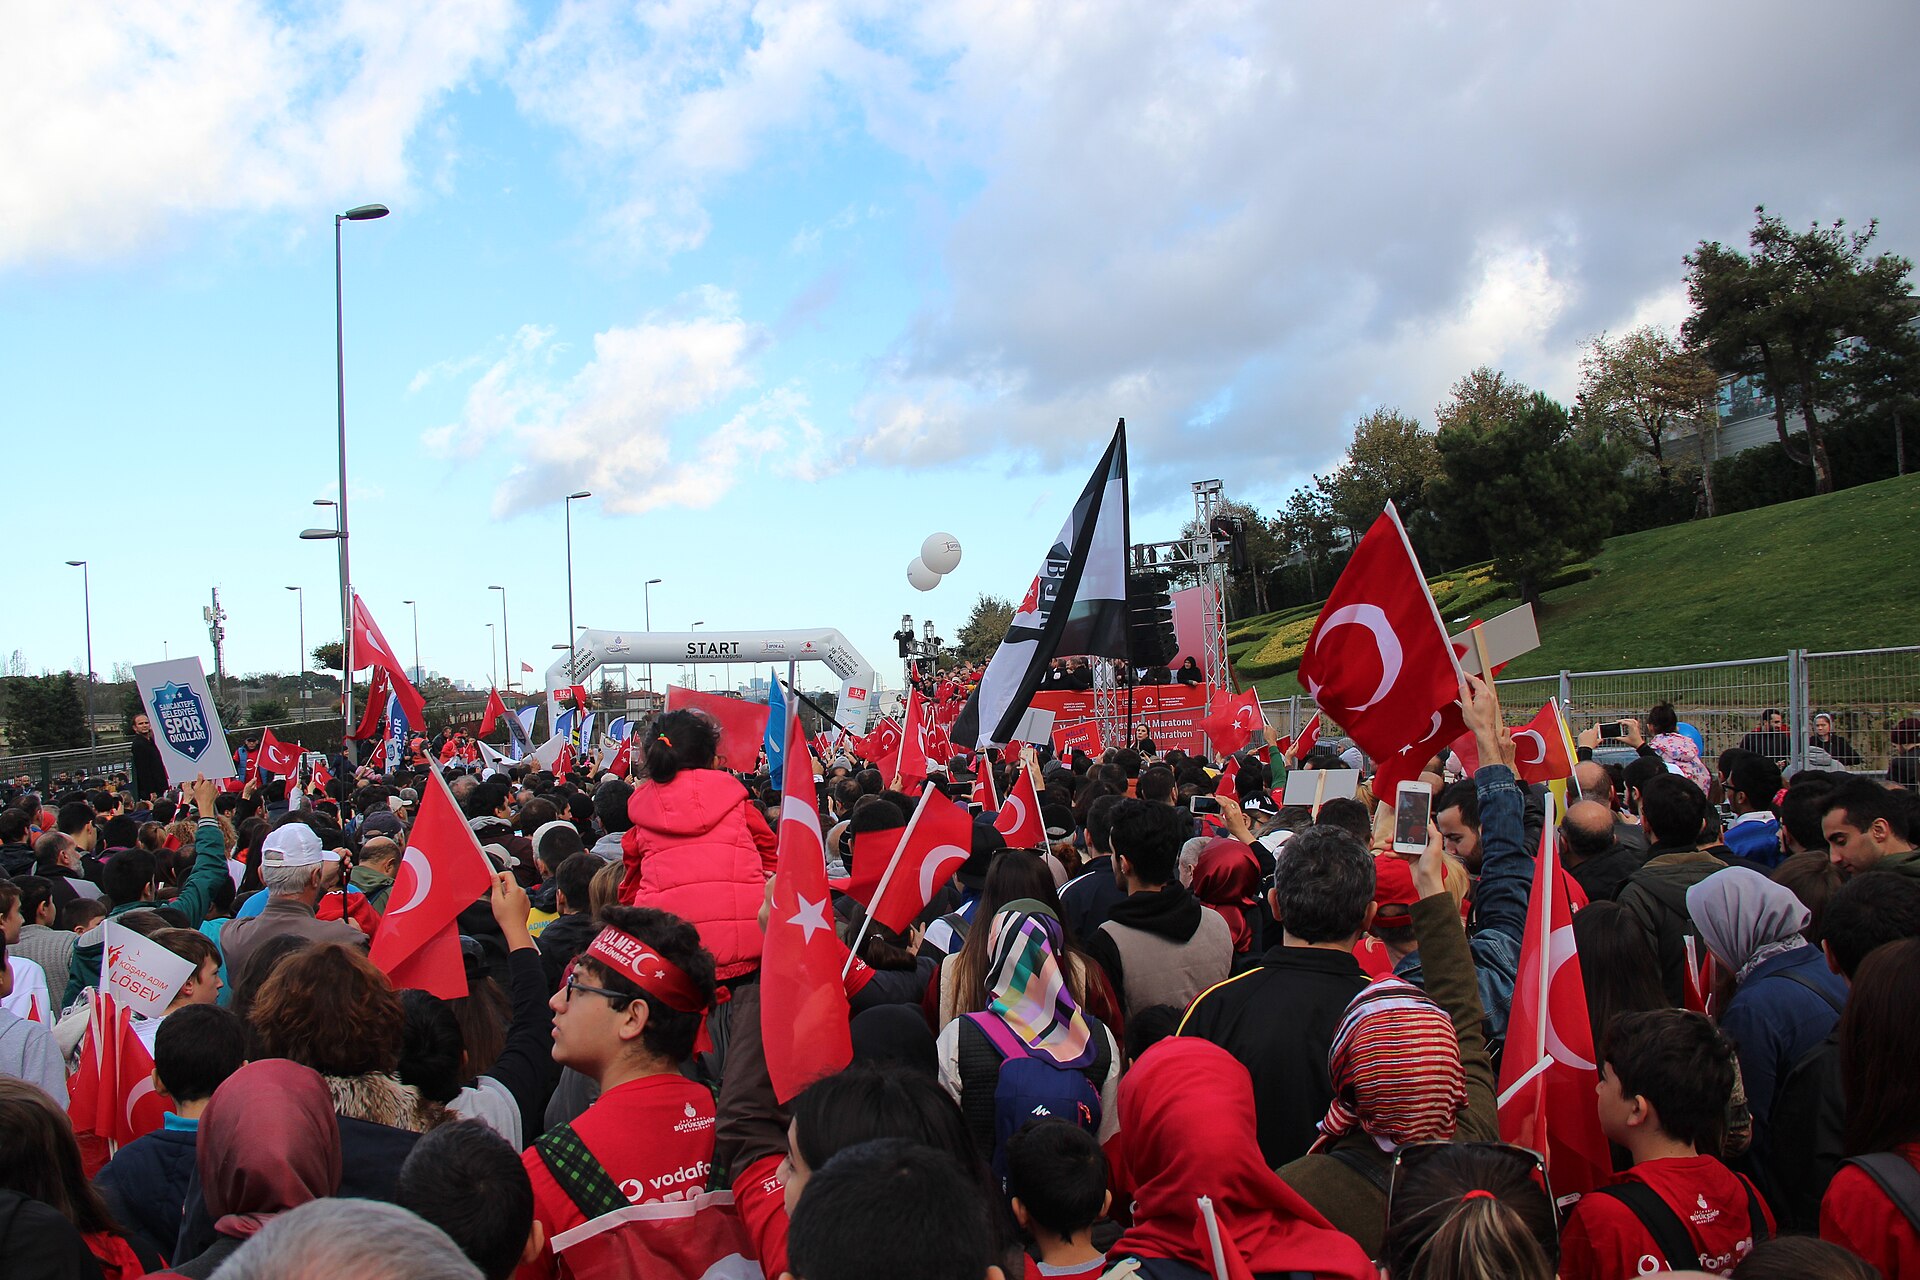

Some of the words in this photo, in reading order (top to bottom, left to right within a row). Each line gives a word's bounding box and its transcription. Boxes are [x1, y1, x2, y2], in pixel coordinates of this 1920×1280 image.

[687, 642, 739, 654] START
[837, 645, 859, 667] Vodafone
[828, 654, 850, 677] Marathon
[159, 700, 196, 710] SANCAKTEPE
[161, 706, 199, 719] BELEDİYESİ
[165, 715, 204, 735] SPOR
[1152, 719, 1193, 729] Maratonu
[169, 730, 207, 743] OKULLARI
[1153, 729, 1193, 740] Marathon
[119, 960, 147, 980] KOŞAR
[147, 976, 169, 991] ADIM
[110, 971, 161, 1002] LÖSEV
[649, 1161, 711, 1190] vodafo
